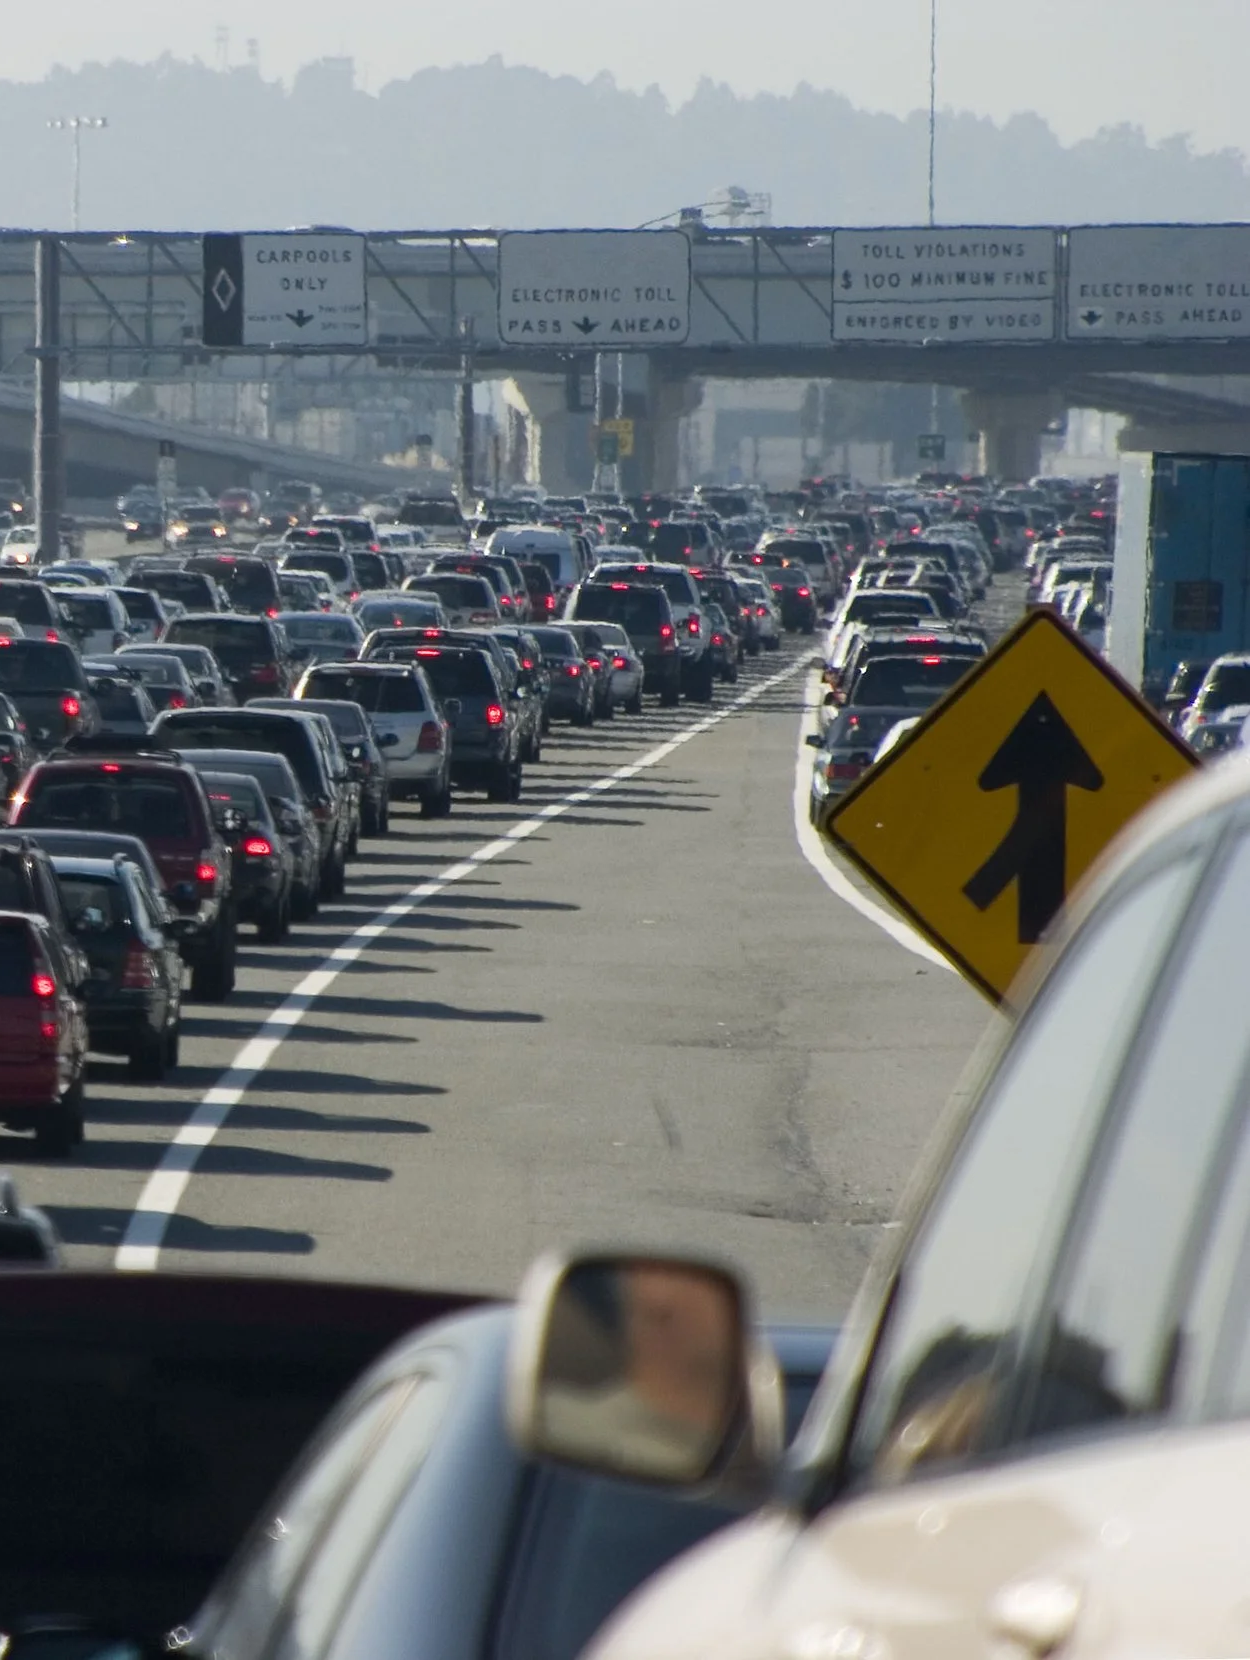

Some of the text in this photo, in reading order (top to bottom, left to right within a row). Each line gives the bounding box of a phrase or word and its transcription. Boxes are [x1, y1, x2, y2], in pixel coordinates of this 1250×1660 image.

[256, 250, 352, 264] CARPOOLS
[862, 243, 1025, 259] TOLL VIOLATIONS
[280, 277, 328, 290] ONLY
[911, 271, 995, 287] MINIMUM
[1004, 271, 1048, 286] FINE
[511, 287, 676, 302] ELECTRONIC TOLL
[1080, 283, 1250, 298] ELECTRONIC TOLL
[508, 316, 682, 334] PASS AHEAD
[845, 315, 1042, 330] ENFORCED BY VIDEO
[1116, 309, 1242, 326] PASS AHEAD
